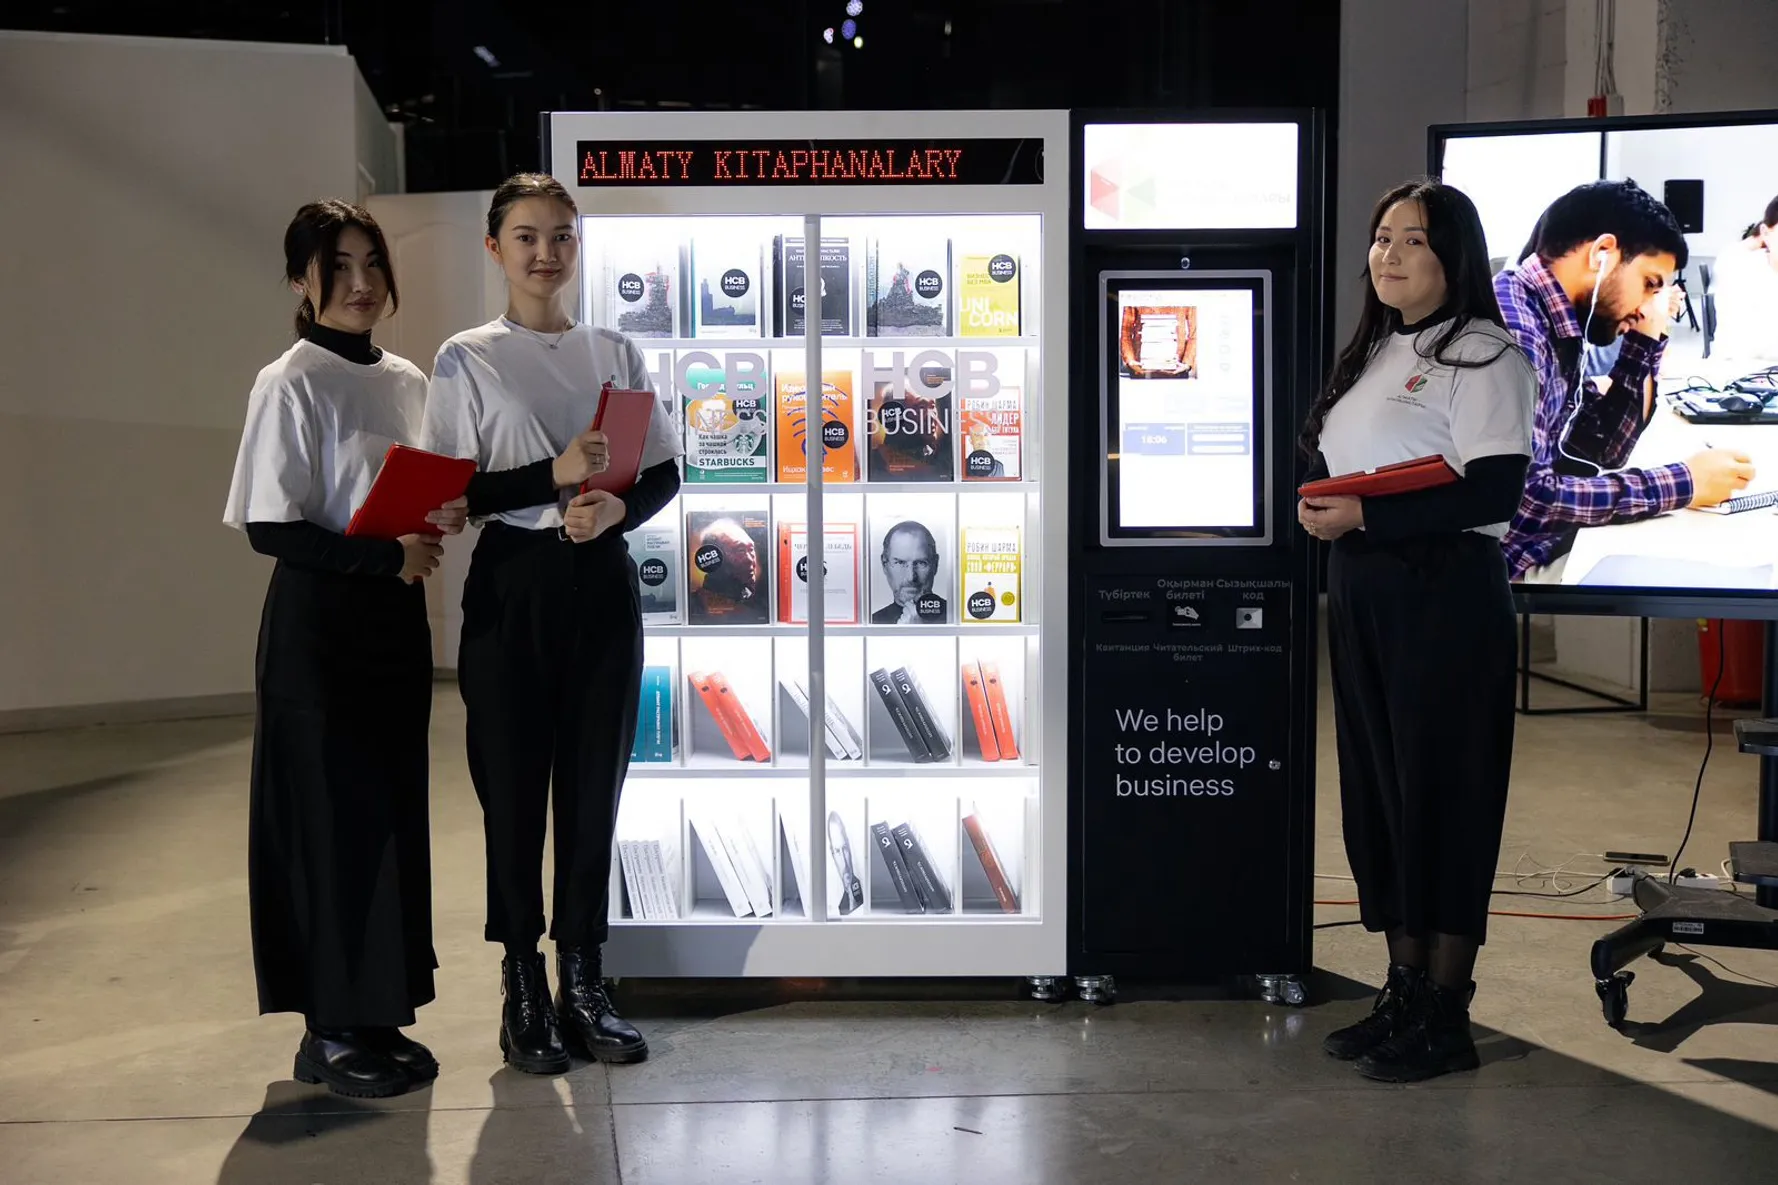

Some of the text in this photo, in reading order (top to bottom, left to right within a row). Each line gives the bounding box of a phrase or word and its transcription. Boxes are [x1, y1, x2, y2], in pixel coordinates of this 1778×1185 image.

[581, 149, 963, 179] ALMATY KITAPHANALARY
[992, 262, 1012, 270] HCB
[622, 281, 641, 289] HCB
[725, 276, 746, 285] HCB
[919, 277, 938, 285] HCB
[792, 295, 805, 303] HC
[969, 311, 1018, 326] CORN
[863, 350, 1001, 400] HCB
[735, 400, 756, 408] HCB
[824, 428, 845, 436] HCB
[699, 458, 755, 466] STARBUCKS
[970, 456, 991, 465] HCB
[697, 549, 719, 563] HCB
[1157, 579, 1216, 589] Оқырман
[1216, 579, 1291, 589] Сызықшалы
[1166, 590, 1205, 600] билеті
[1242, 591, 1265, 601] код
[920, 600, 941, 608] HCB
[1173, 654, 1204, 662] билет
[1115, 707, 1224, 737] We help
[1114, 740, 1256, 769] to develop
[1116, 773, 1235, 796] business
